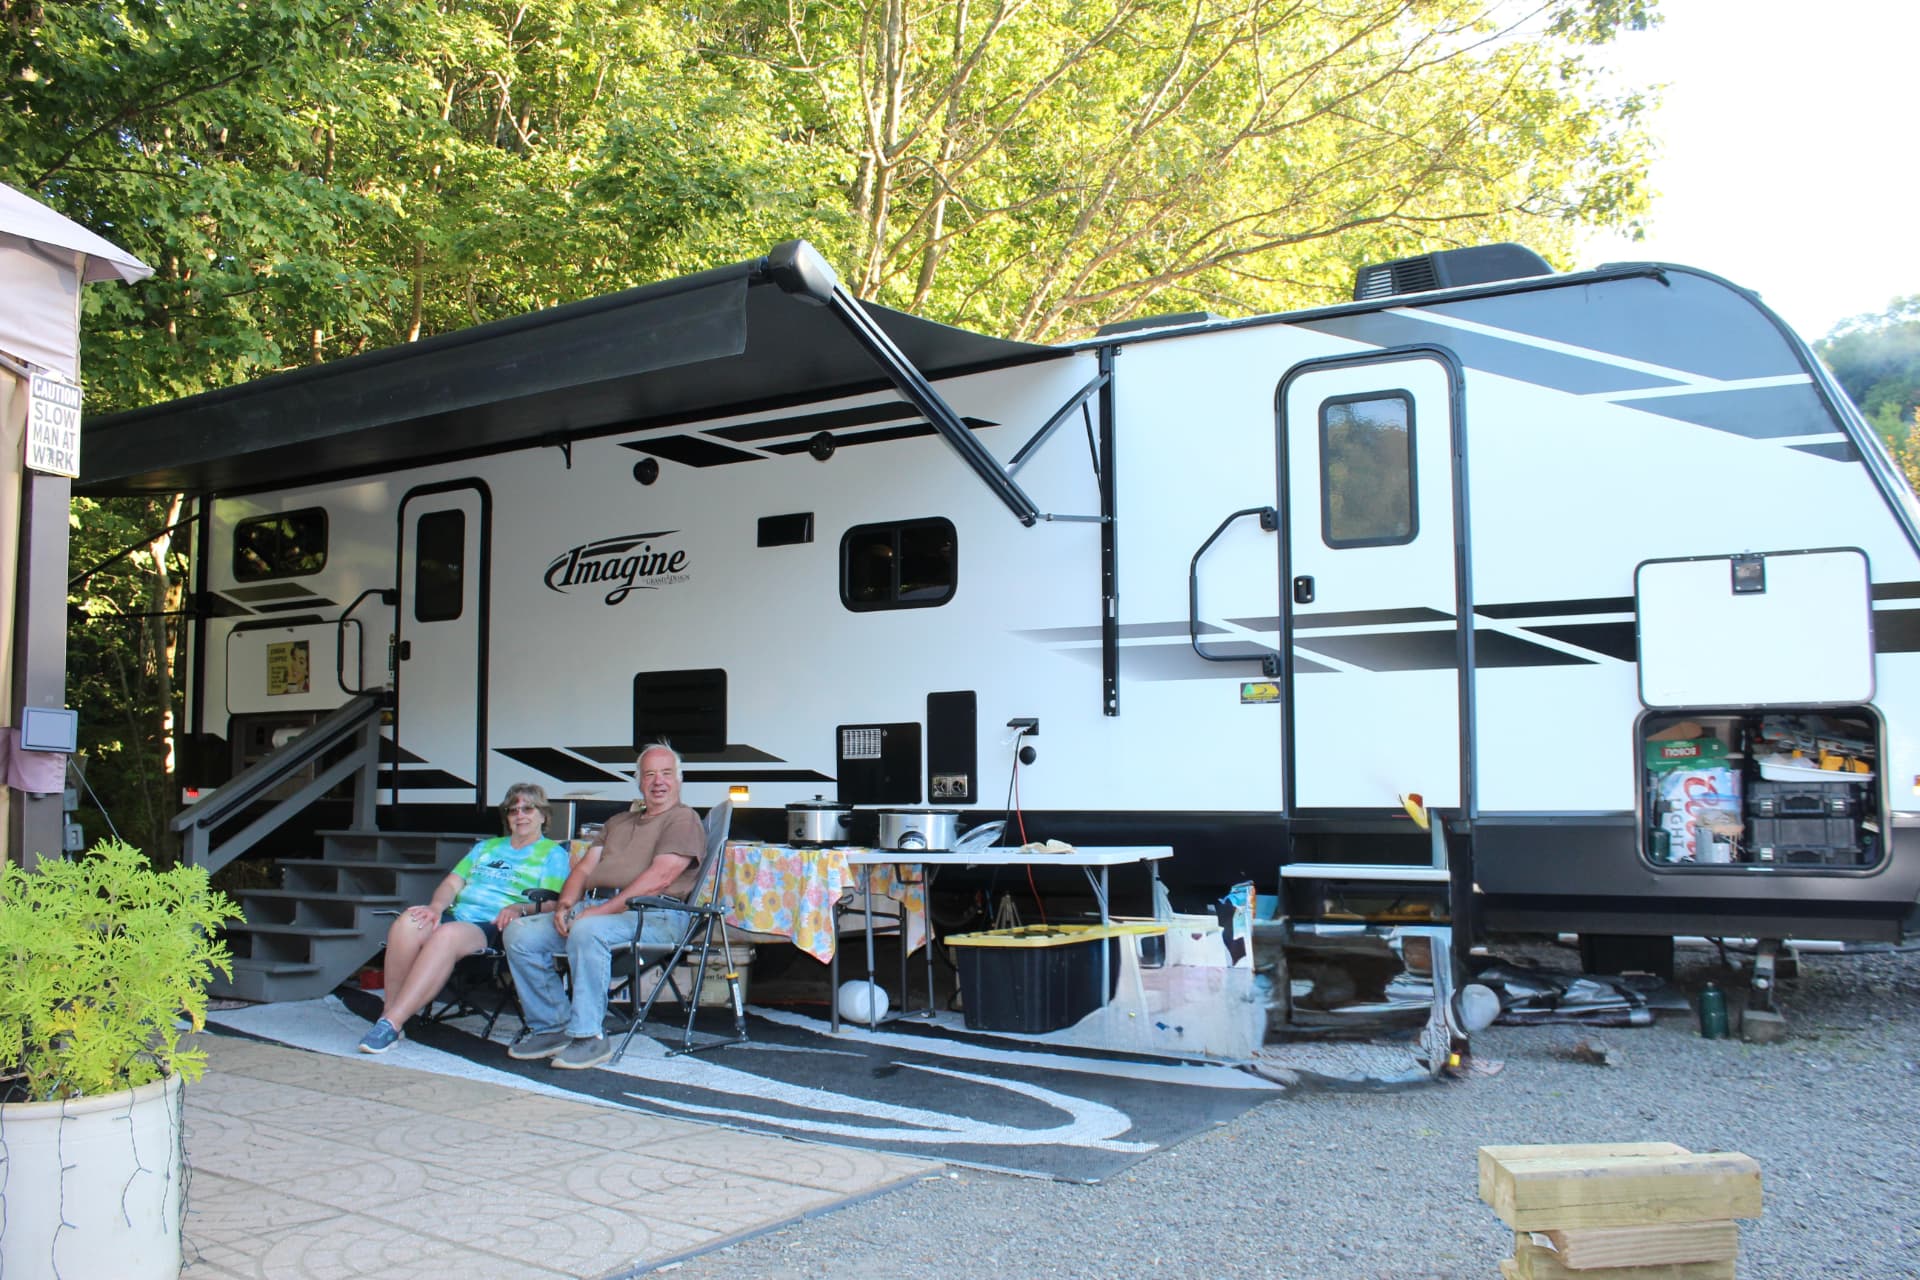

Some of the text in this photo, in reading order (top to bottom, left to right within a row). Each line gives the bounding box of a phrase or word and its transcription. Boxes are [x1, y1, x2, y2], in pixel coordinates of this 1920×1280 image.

[34, 378, 79, 408] CAUTION
[34, 401, 76, 429] SLOW
[33, 422, 76, 451] MAN AT
[33, 444, 74, 472] WRK
[553, 541, 692, 606] Imagine
